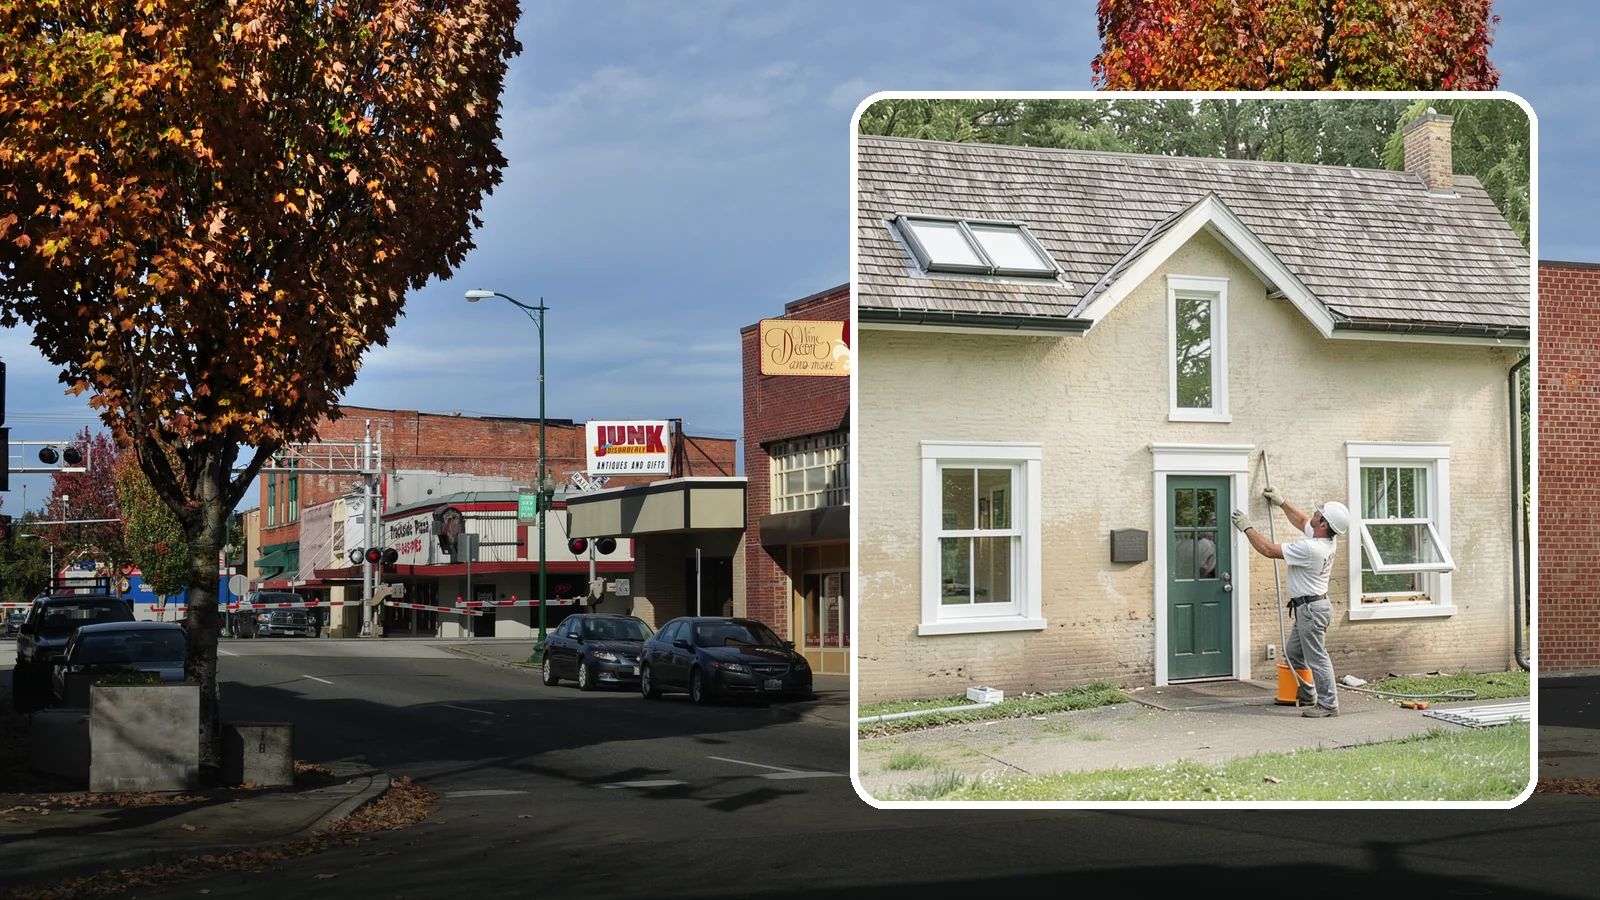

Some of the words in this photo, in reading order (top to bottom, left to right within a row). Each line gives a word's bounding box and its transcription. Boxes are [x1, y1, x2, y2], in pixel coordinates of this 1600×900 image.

[595, 425, 664, 457] JUNK
[607, 446, 646, 454] DISORDERLY
[596, 461, 628, 470] ANTIQUES
[631, 461, 644, 470] AND
[647, 461, 665, 470] GIFTS
[390, 521, 413, 539] Trackside
[414, 519, 429, 535] Pizza
